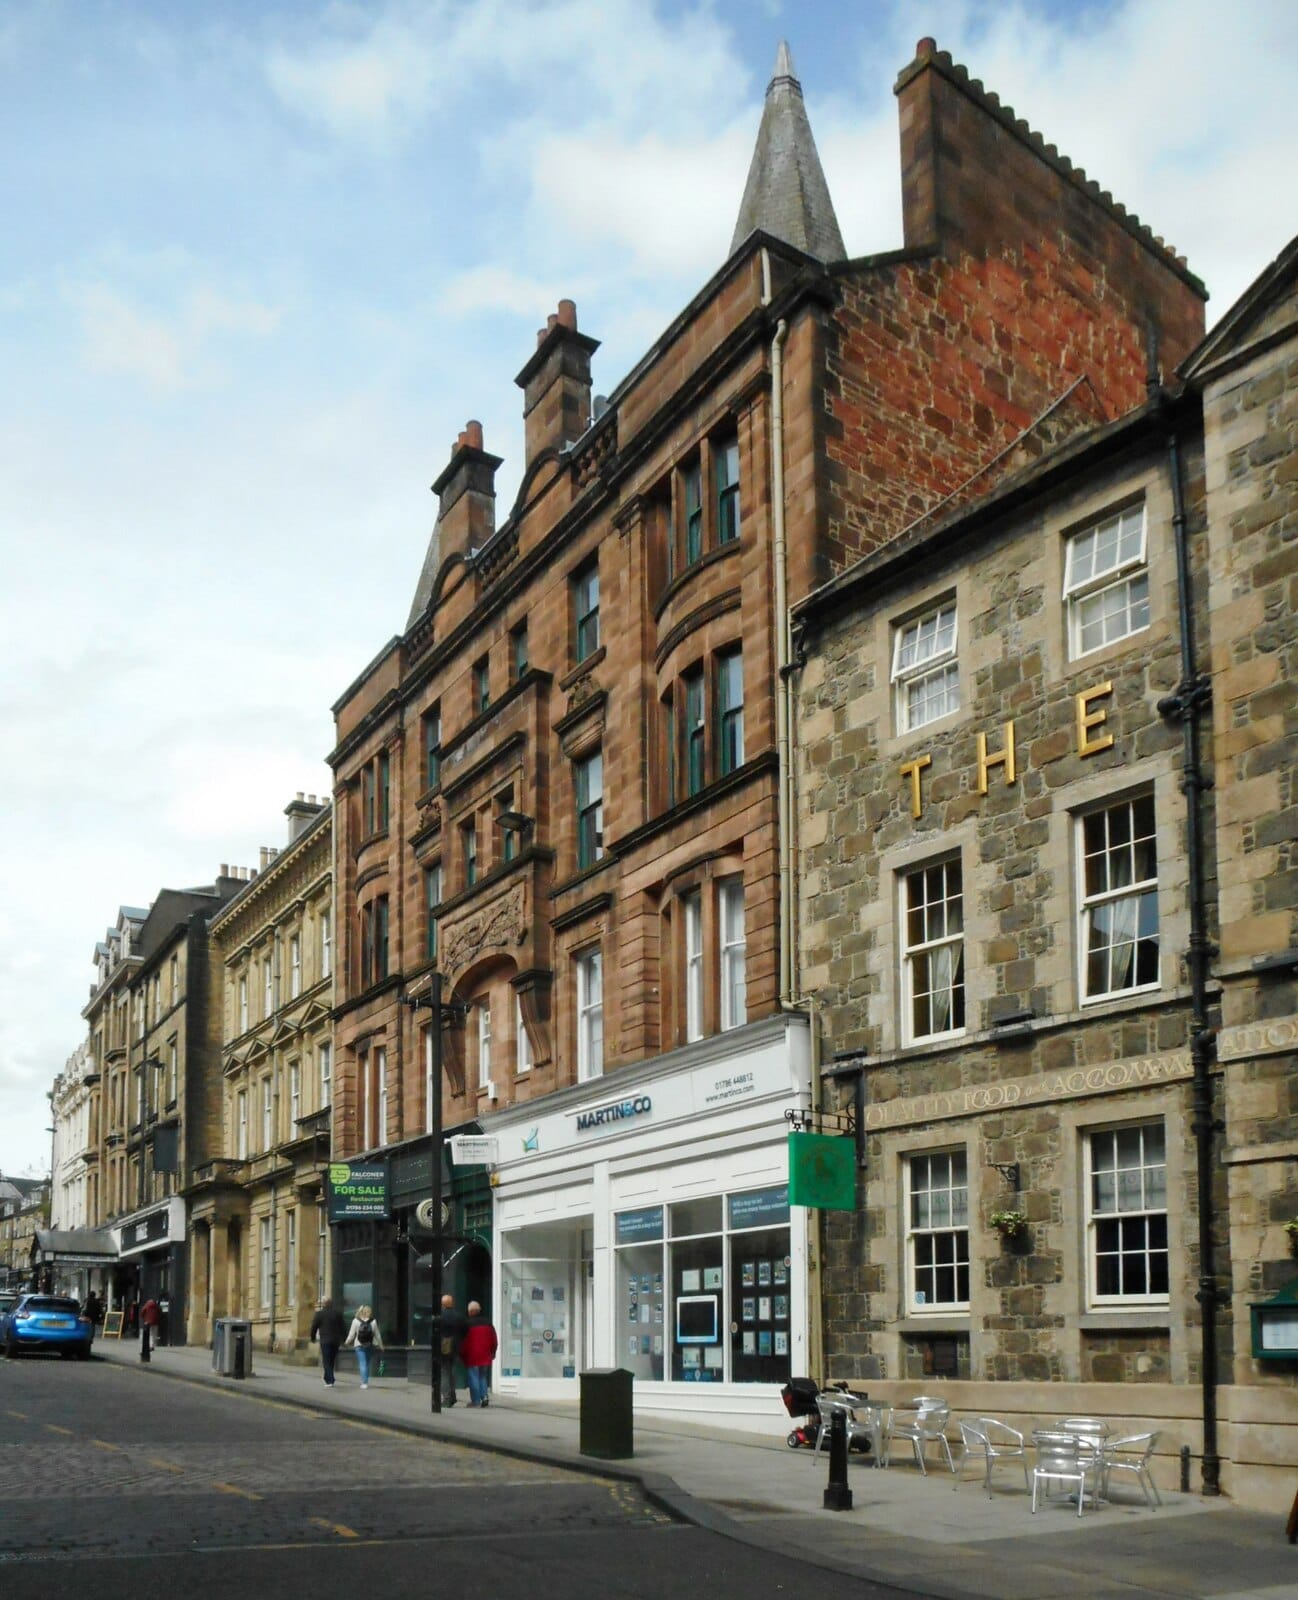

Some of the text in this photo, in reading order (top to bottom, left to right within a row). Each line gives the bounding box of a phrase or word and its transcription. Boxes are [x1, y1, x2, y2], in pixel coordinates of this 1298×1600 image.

[900, 680, 1114, 820] THE
[866, 1098, 955, 1127] QUALITY
[963, 1084, 1021, 1110] FOOD
[1049, 1052, 1194, 1096] ACCOMM
[1221, 1023, 1298, 1064] ATIO
[576, 1096, 652, 1131] MARTIN&CO
[334, 1185, 385, 1195] FOR SALE
